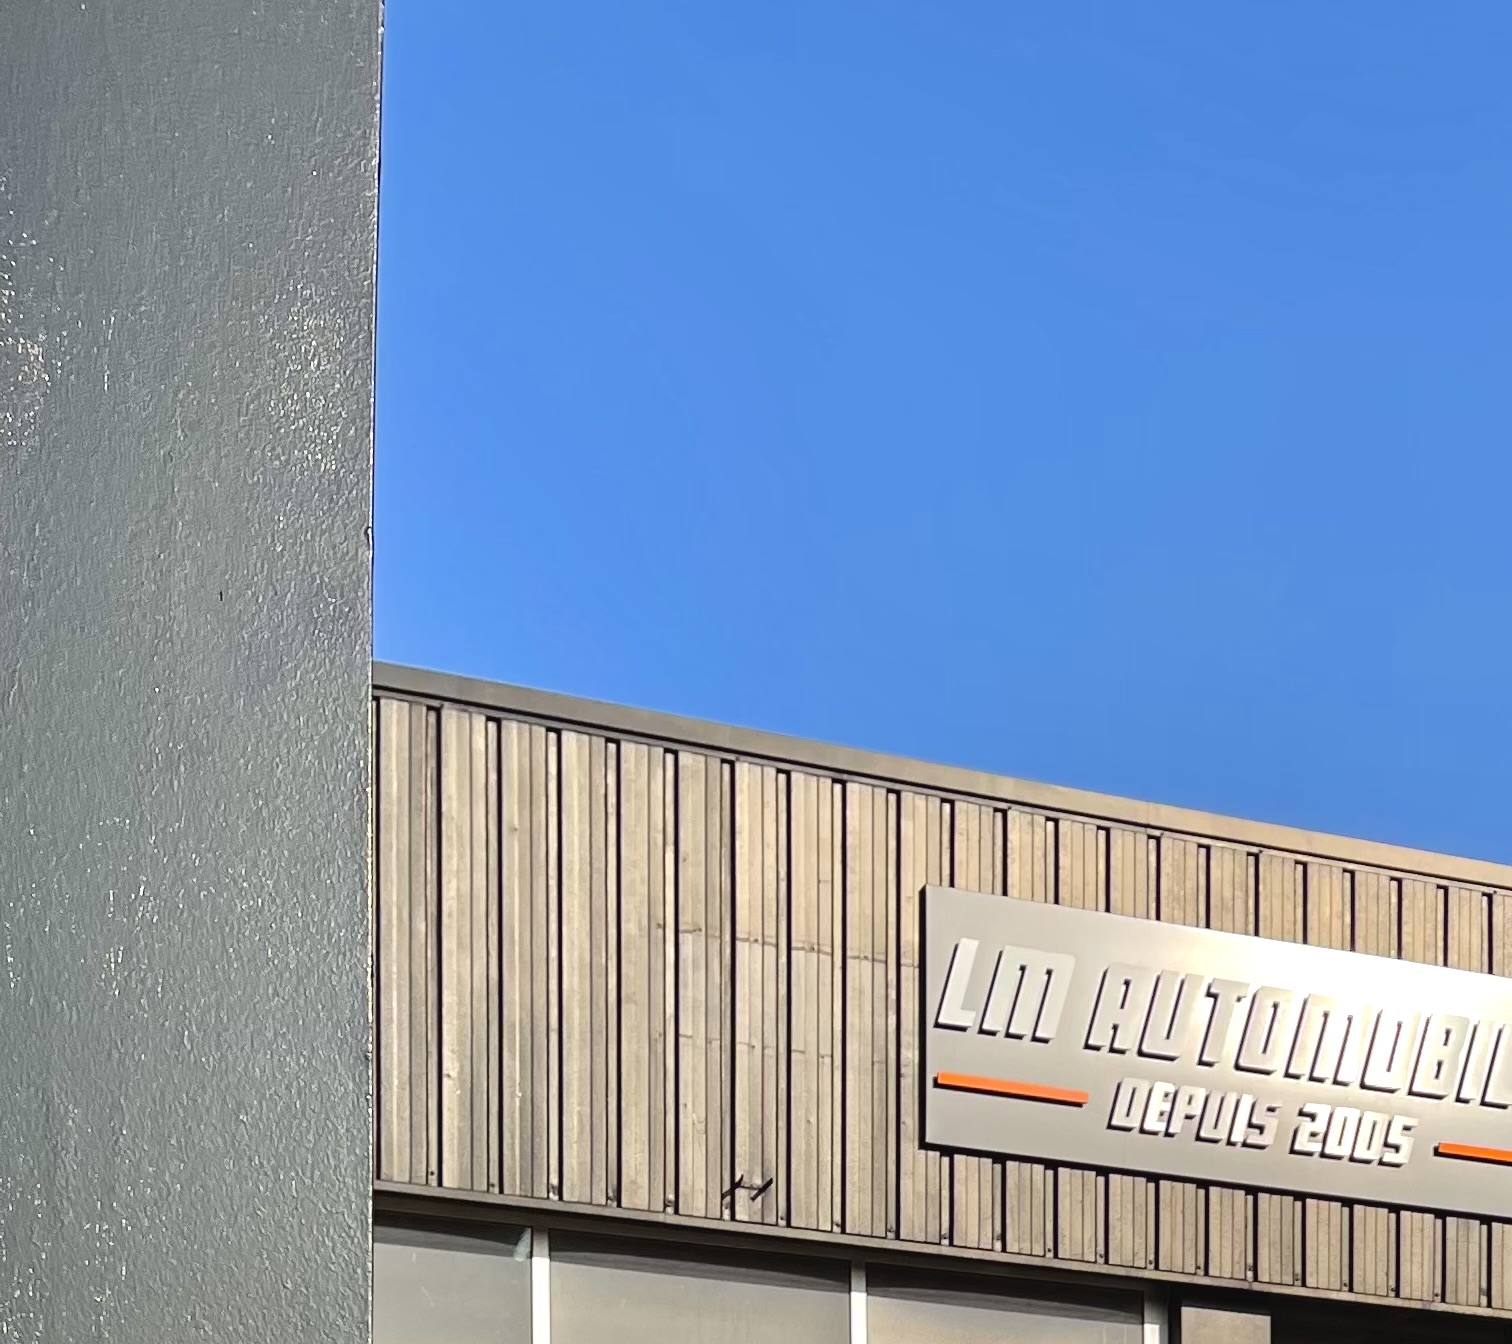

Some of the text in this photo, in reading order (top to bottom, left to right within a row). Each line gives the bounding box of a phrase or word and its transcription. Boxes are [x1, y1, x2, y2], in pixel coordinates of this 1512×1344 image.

[934, 938, 1075, 1042] LM
[1107, 1078, 1418, 1166] DEPUIS 2005
